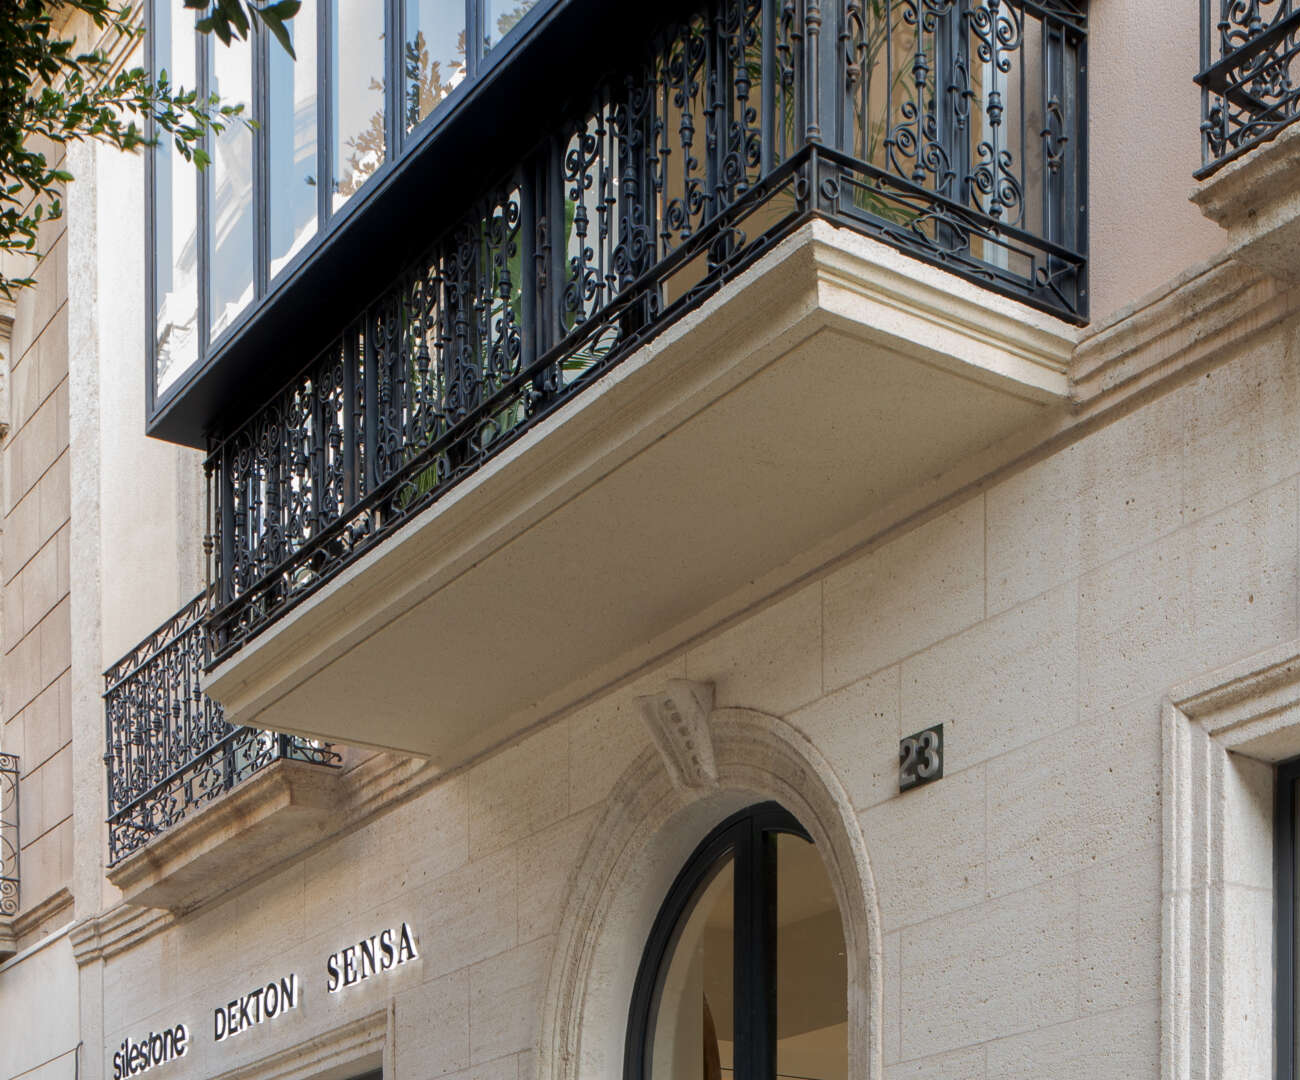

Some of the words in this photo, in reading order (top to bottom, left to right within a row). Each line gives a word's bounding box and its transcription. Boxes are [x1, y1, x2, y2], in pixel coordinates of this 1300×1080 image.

[899, 730, 939, 787] 23
[326, 921, 417, 993] SENSA
[214, 972, 297, 1042] DEKTON
